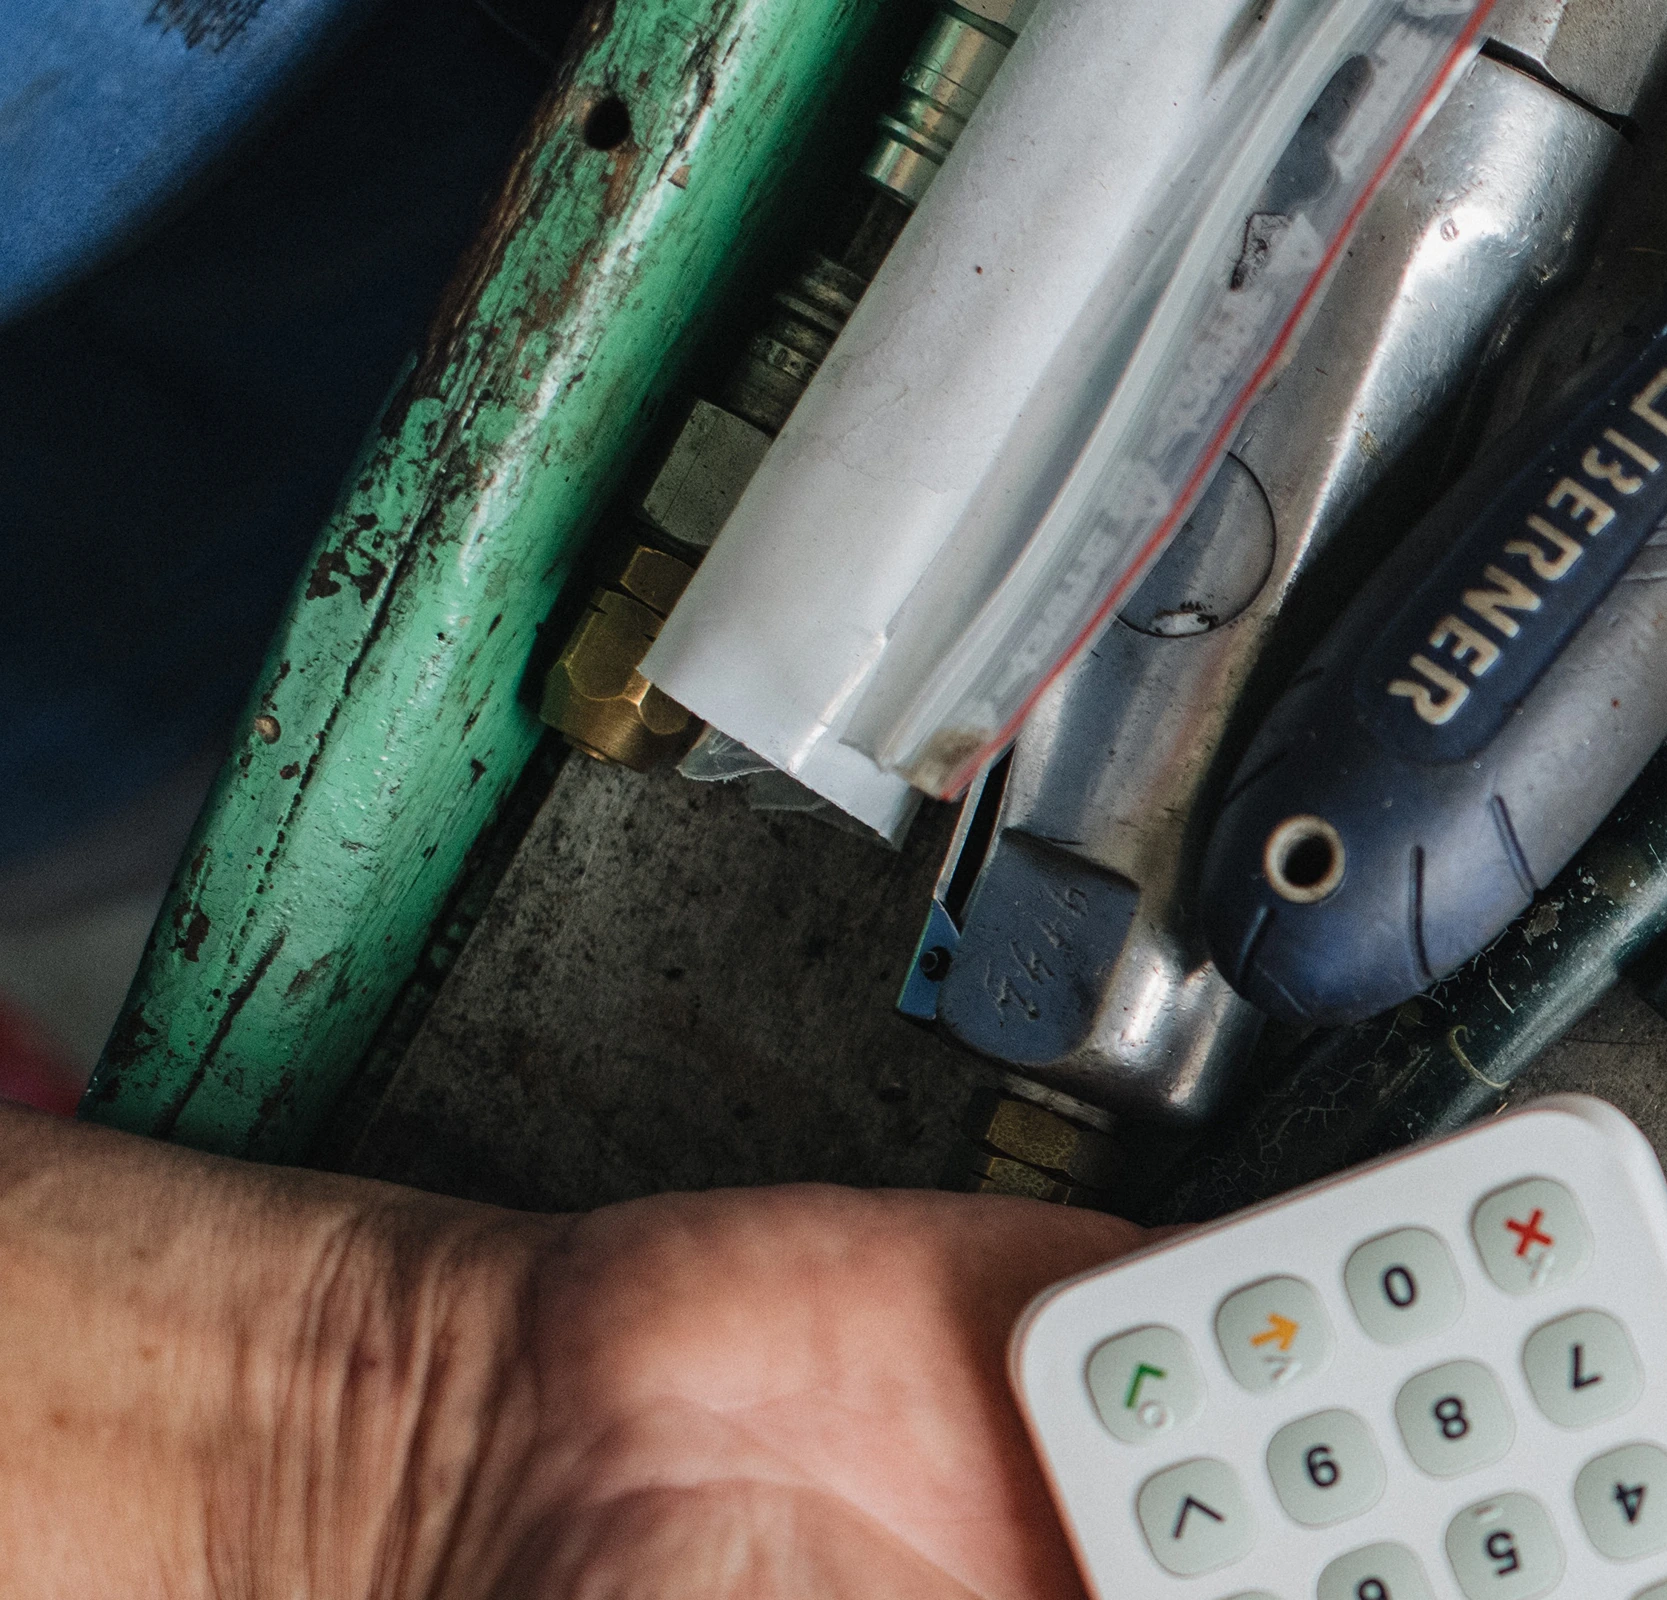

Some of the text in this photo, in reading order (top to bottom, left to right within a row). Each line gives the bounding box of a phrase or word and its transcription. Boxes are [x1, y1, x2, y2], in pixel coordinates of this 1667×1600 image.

[1381, 1265, 1417, 1309] 0
[1304, 1344, 1600, 1489] 7 8 9
[1614, 1483, 1645, 1524] 4
[1484, 1530, 1519, 1576] 5
